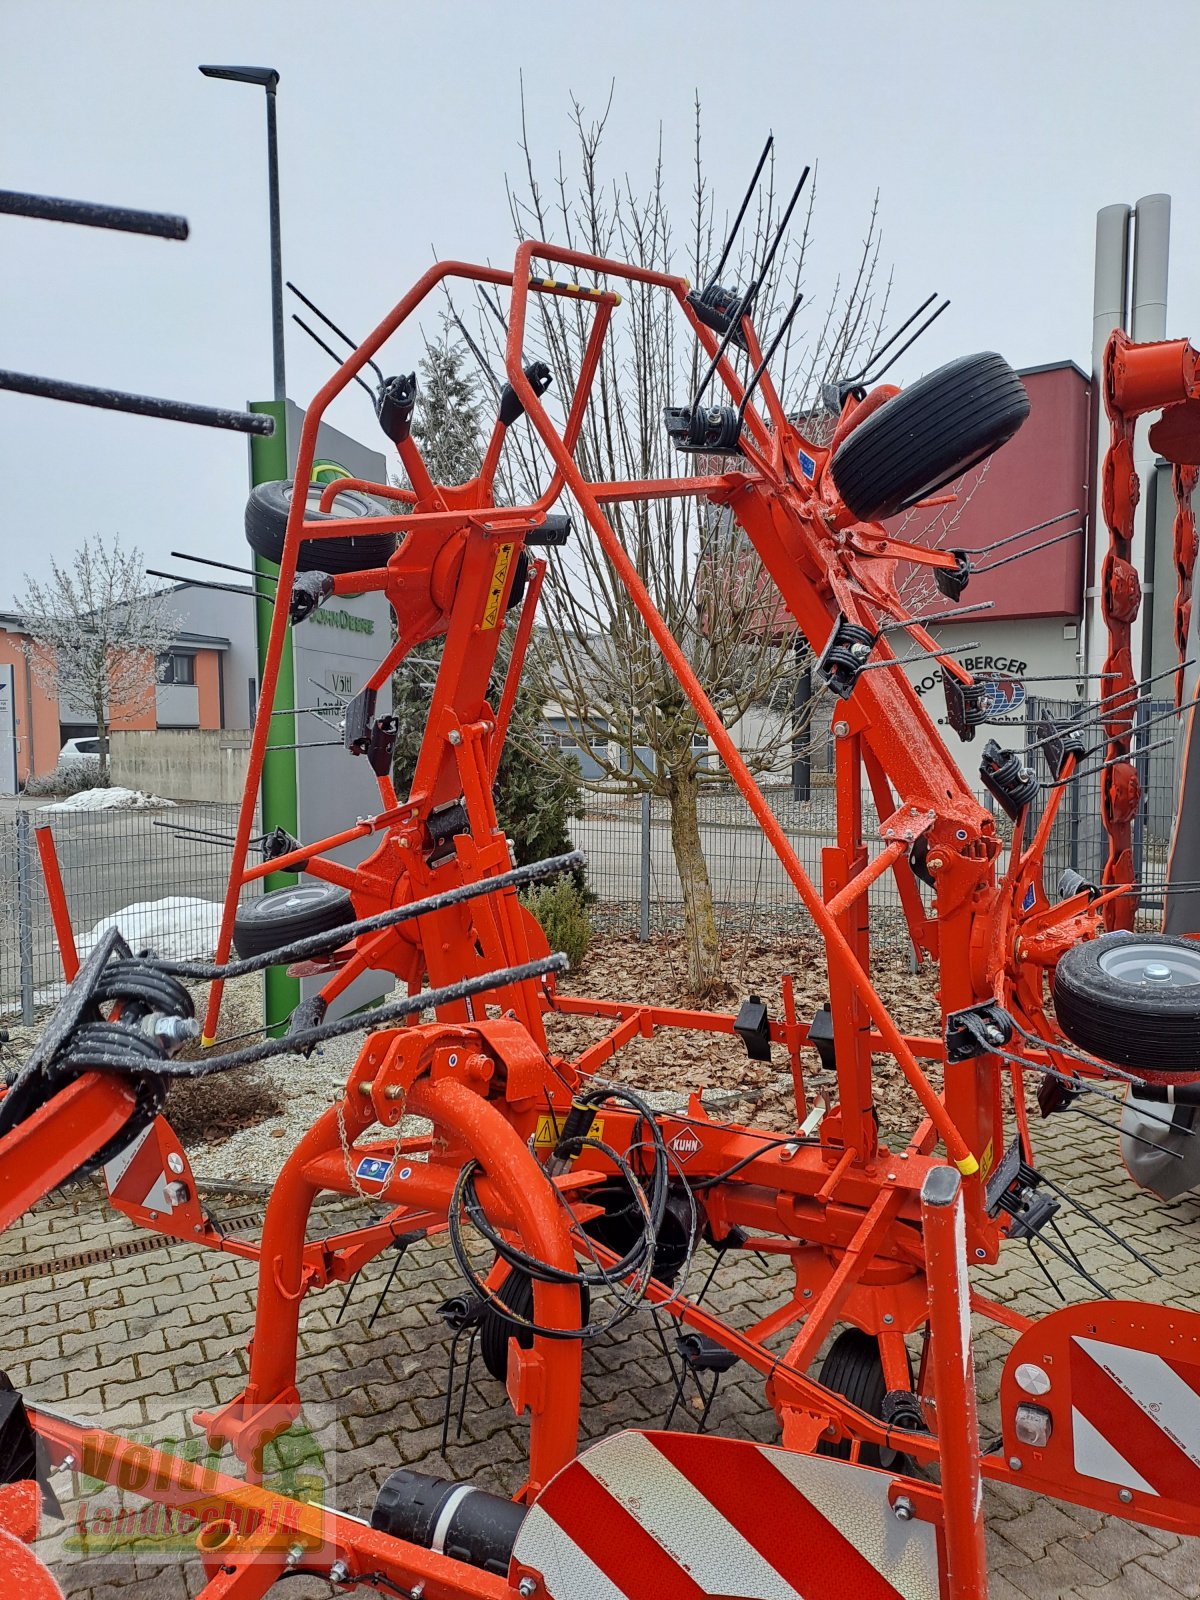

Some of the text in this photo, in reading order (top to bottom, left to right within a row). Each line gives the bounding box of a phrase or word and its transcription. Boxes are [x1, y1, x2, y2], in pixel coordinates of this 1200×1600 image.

[332, 674, 351, 693] Völtl
[914, 656, 1027, 697] ROSBERGER
[672, 1139, 698, 1151] KUHN
